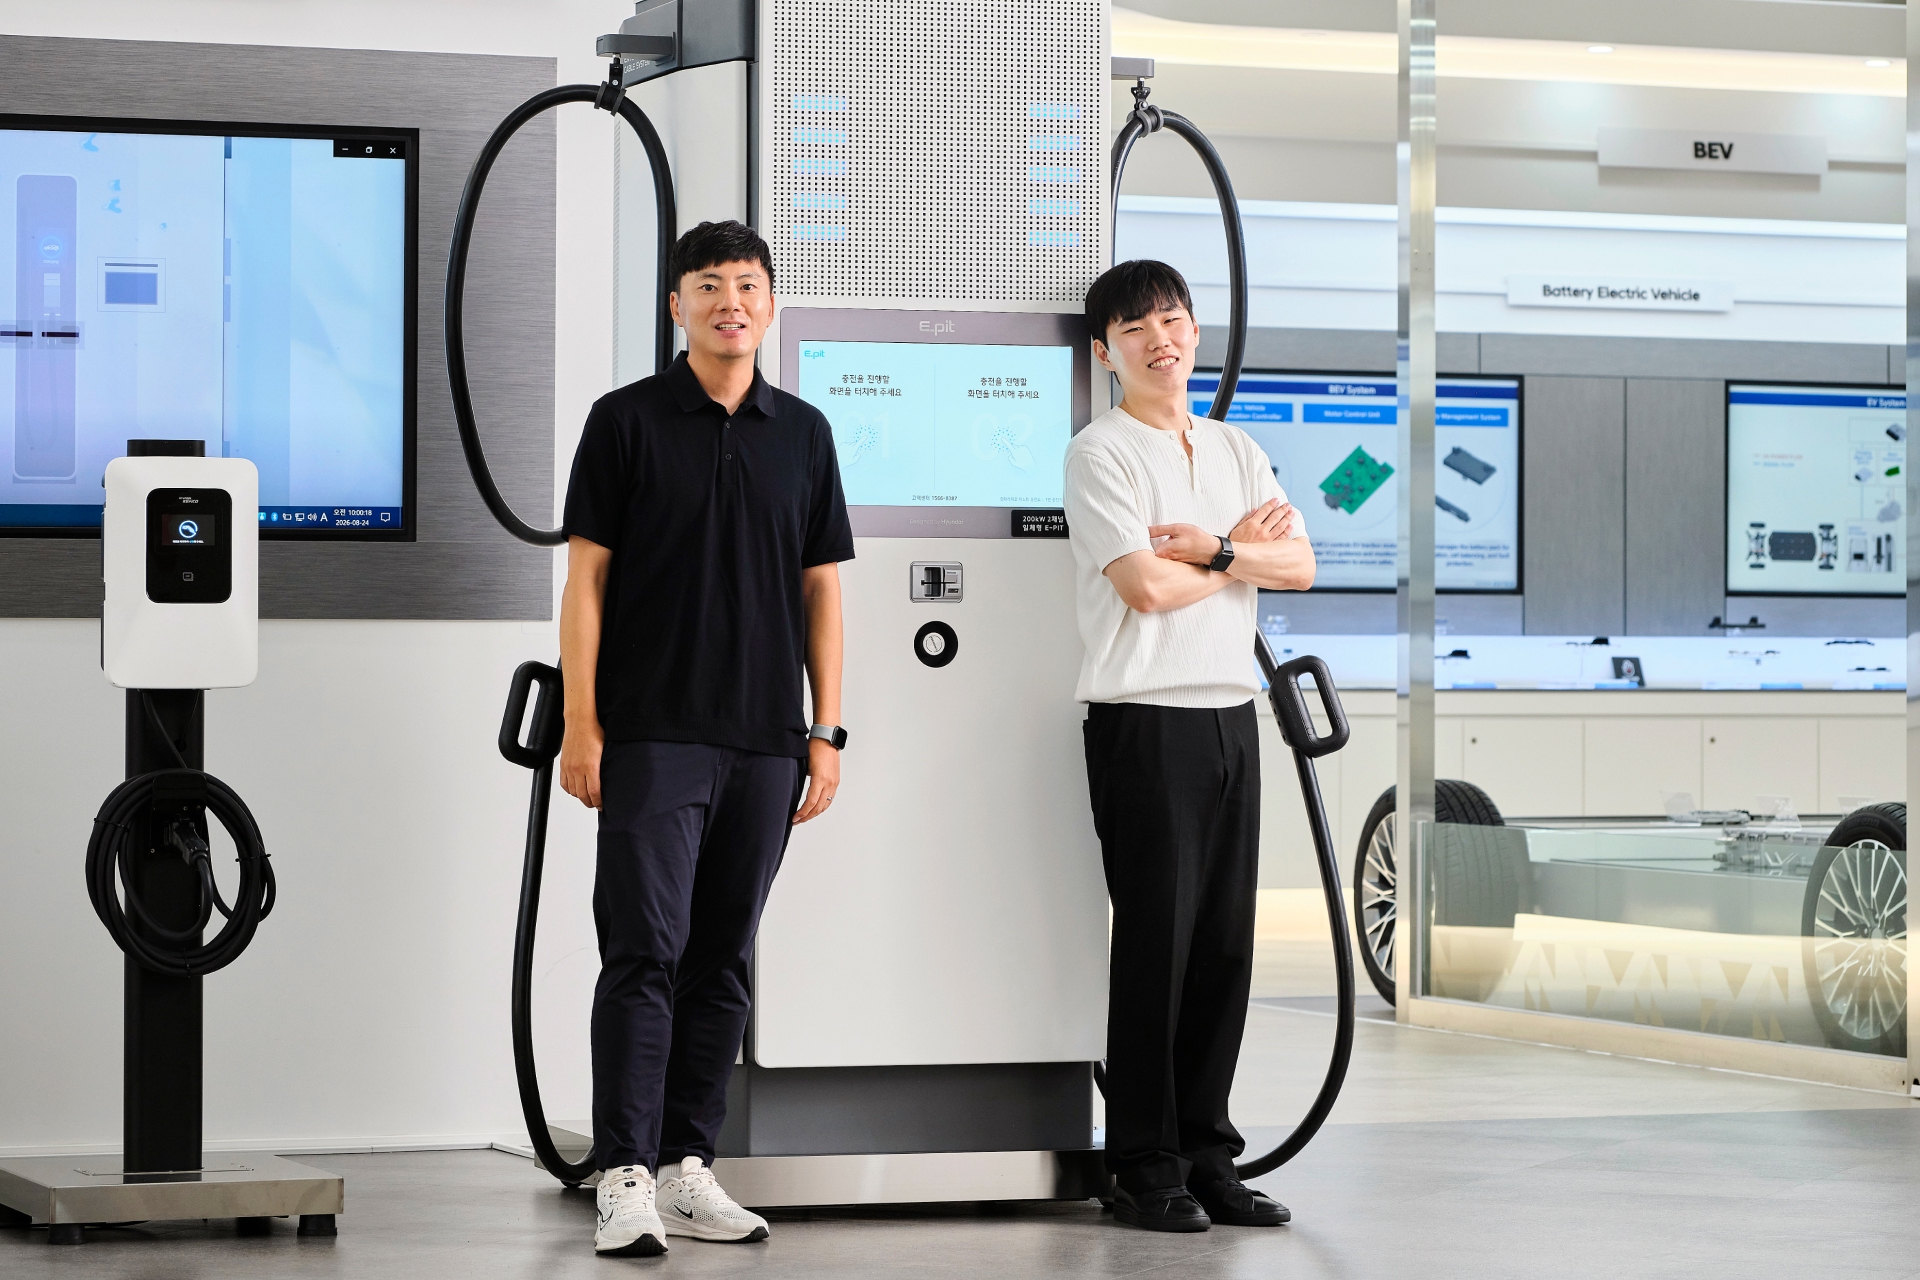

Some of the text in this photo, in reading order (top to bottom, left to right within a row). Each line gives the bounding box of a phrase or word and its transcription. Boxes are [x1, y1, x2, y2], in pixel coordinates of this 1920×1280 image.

[624, 64, 635, 74] CABLE
[1692, 142, 1733, 159] BEV
[1543, 284, 1700, 302] Battery Electric Vehicle
[842, 374, 890, 384] 충전을 진행할
[980, 377, 1027, 387] 충전을 진행할
[829, 387, 902, 397] 화면을 터치해 주세요
[967, 389, 1040, 399] 화면을 터치해 주세요
[941, 518, 964, 526] Hyundai
[1022, 515, 1064, 523] 200kW 2채널
[1022, 524, 1064, 532] 일체형 E-PIT
